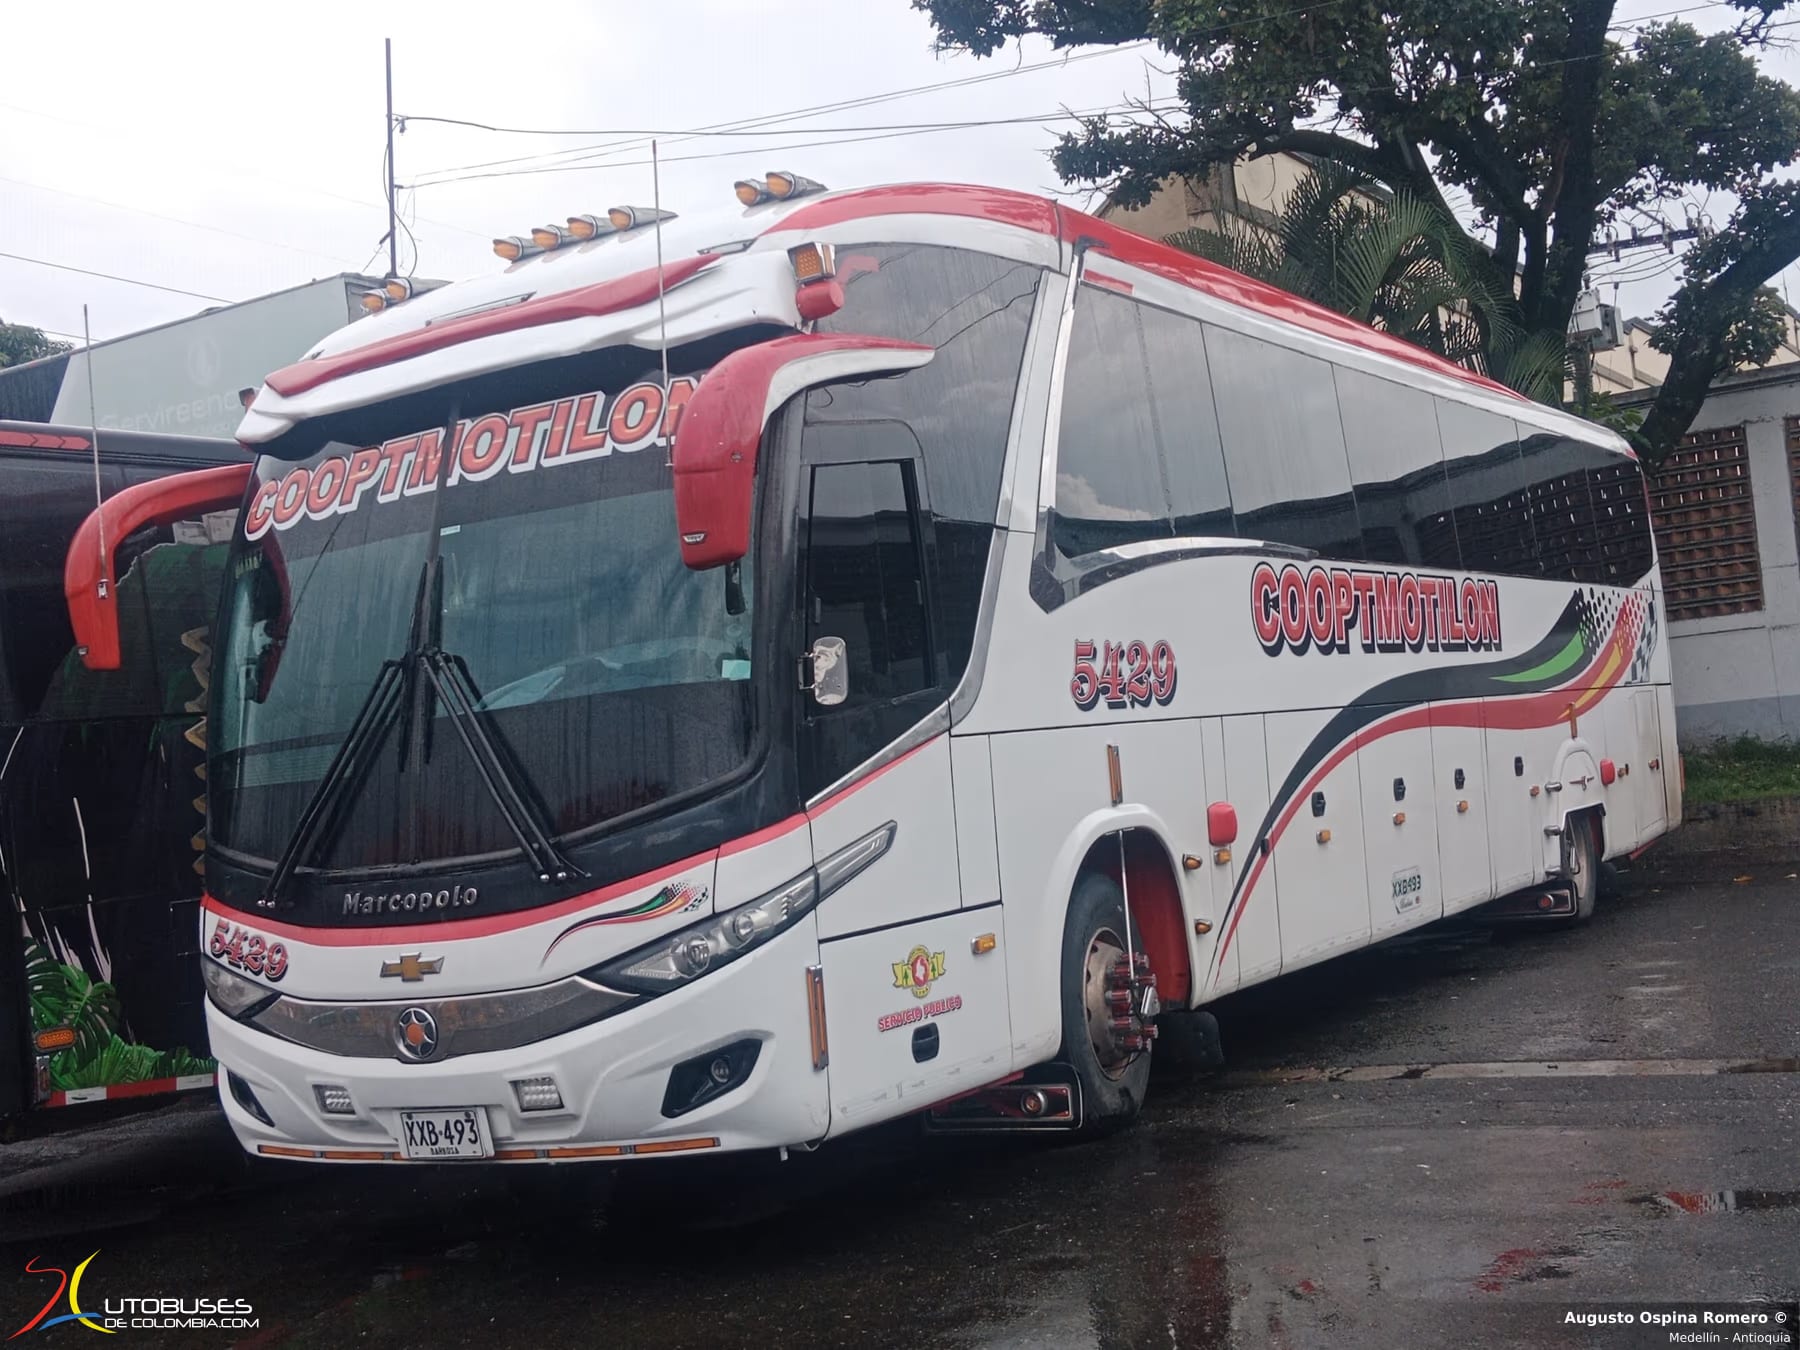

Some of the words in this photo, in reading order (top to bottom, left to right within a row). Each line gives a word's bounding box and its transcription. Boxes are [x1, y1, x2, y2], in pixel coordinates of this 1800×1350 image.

[1250, 561, 1502, 657] COOPTMOTILON
[1070, 639, 1177, 711] 5429
[342, 885, 477, 915] Marcopolo
[210, 918, 288, 982] 5429
